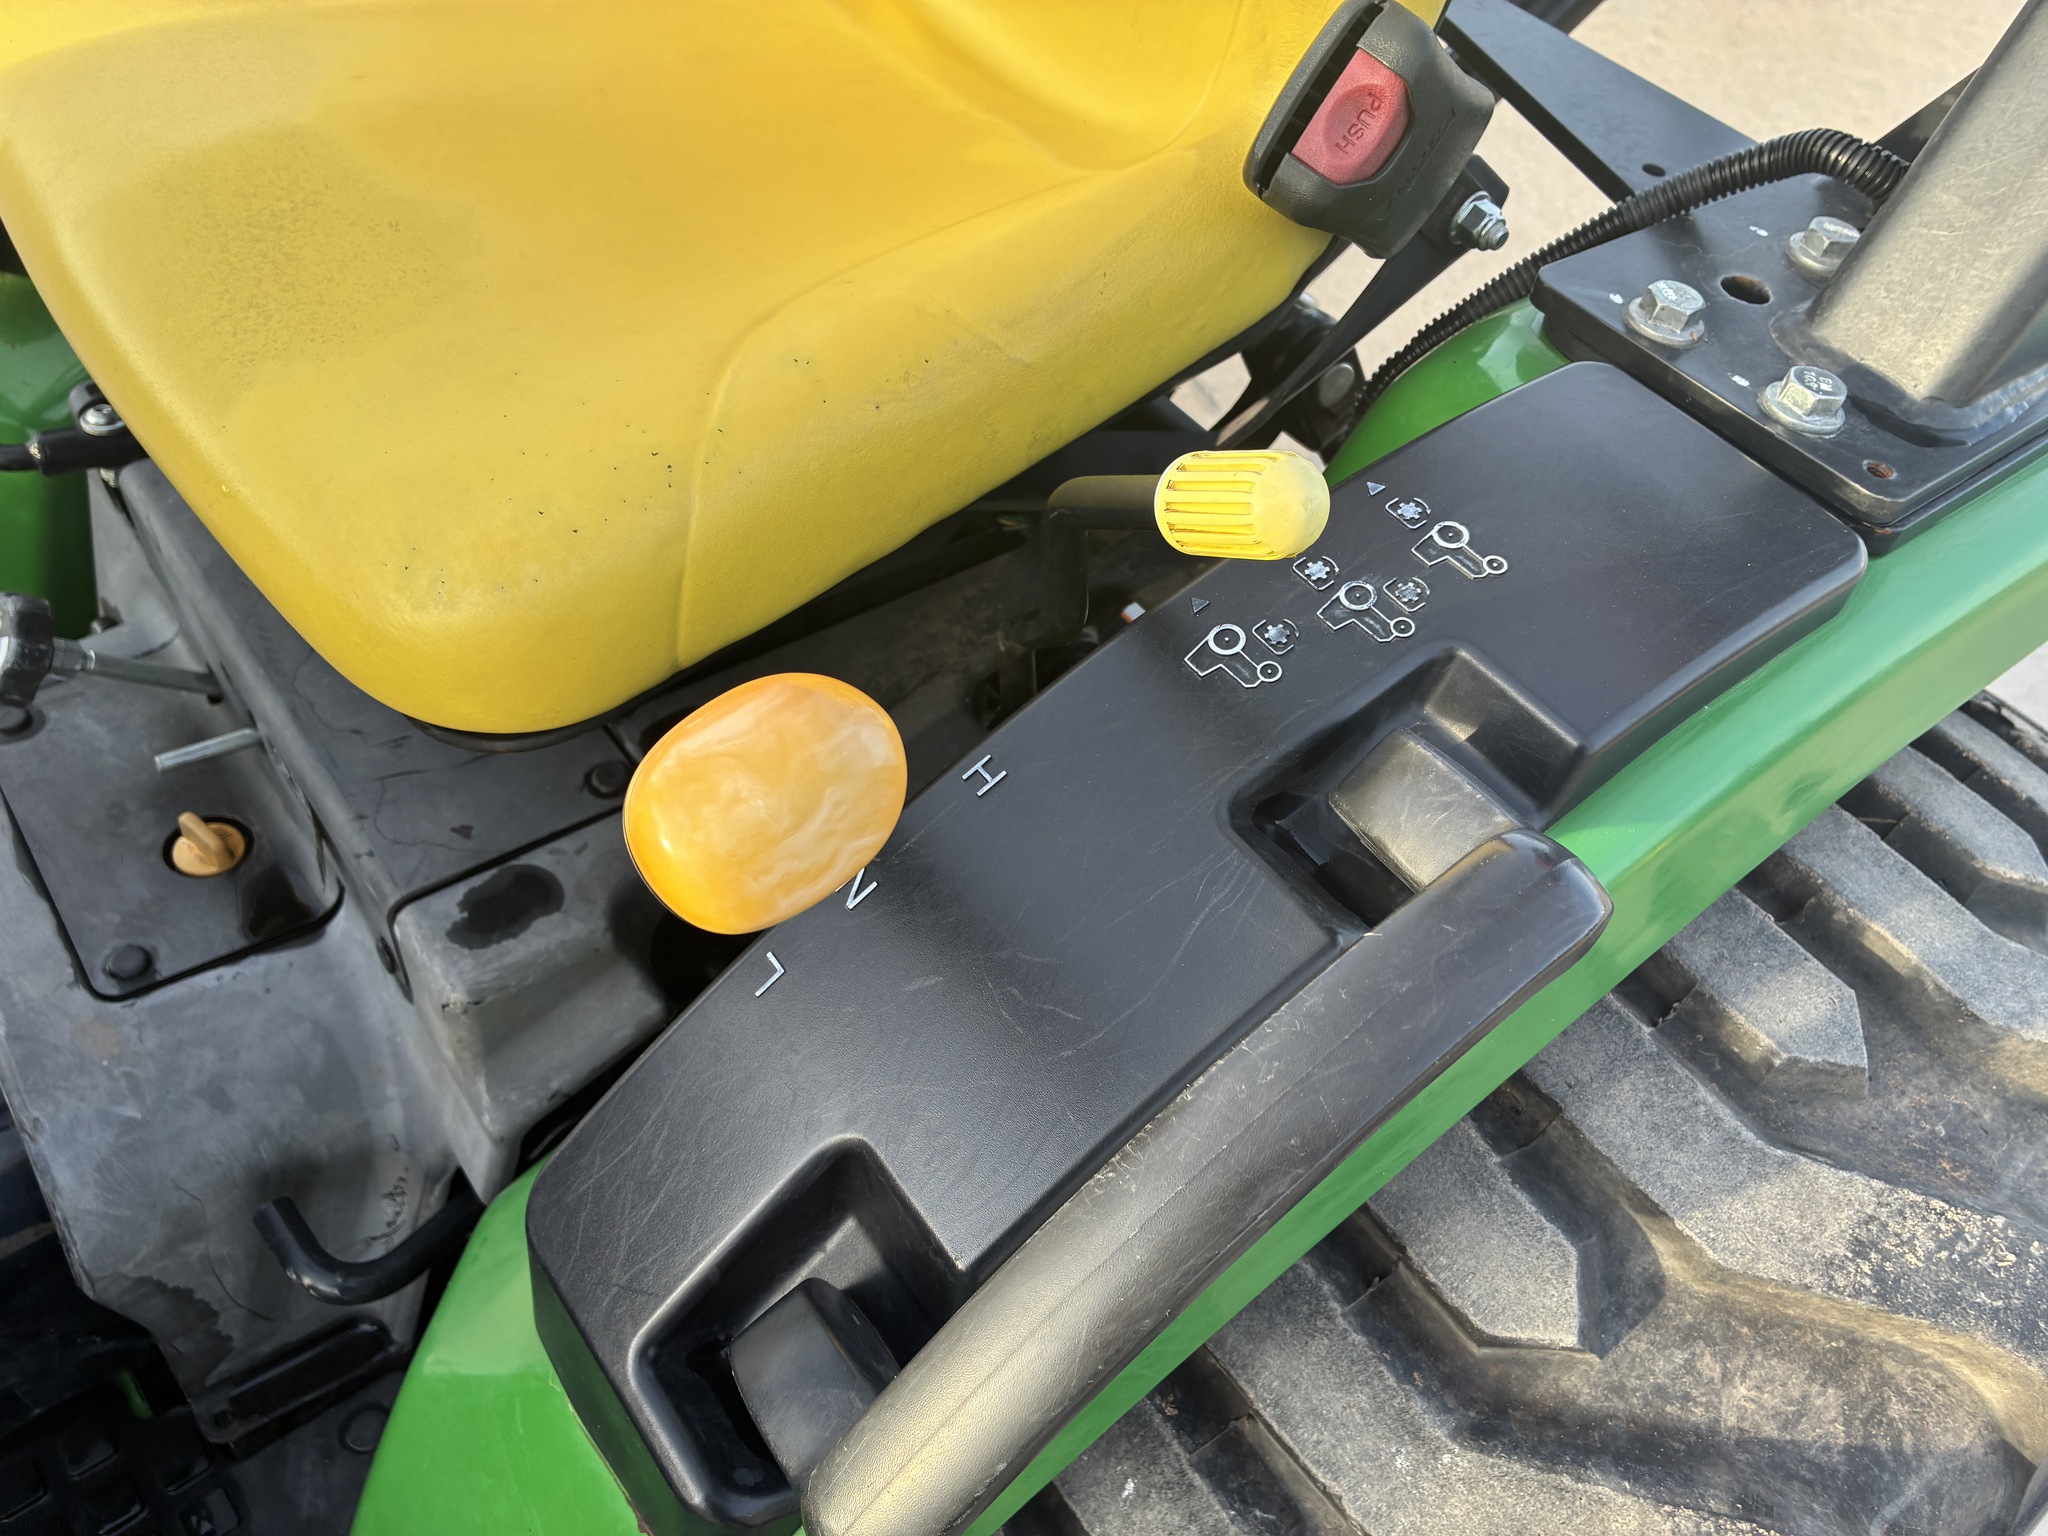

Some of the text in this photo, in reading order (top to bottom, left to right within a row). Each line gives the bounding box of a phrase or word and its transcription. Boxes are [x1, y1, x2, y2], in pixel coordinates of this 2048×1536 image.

[1335, 92, 1382, 155] PUSH
[962, 754, 1007, 797] H
[834, 867, 878, 911] N
[754, 952, 785, 998] L
